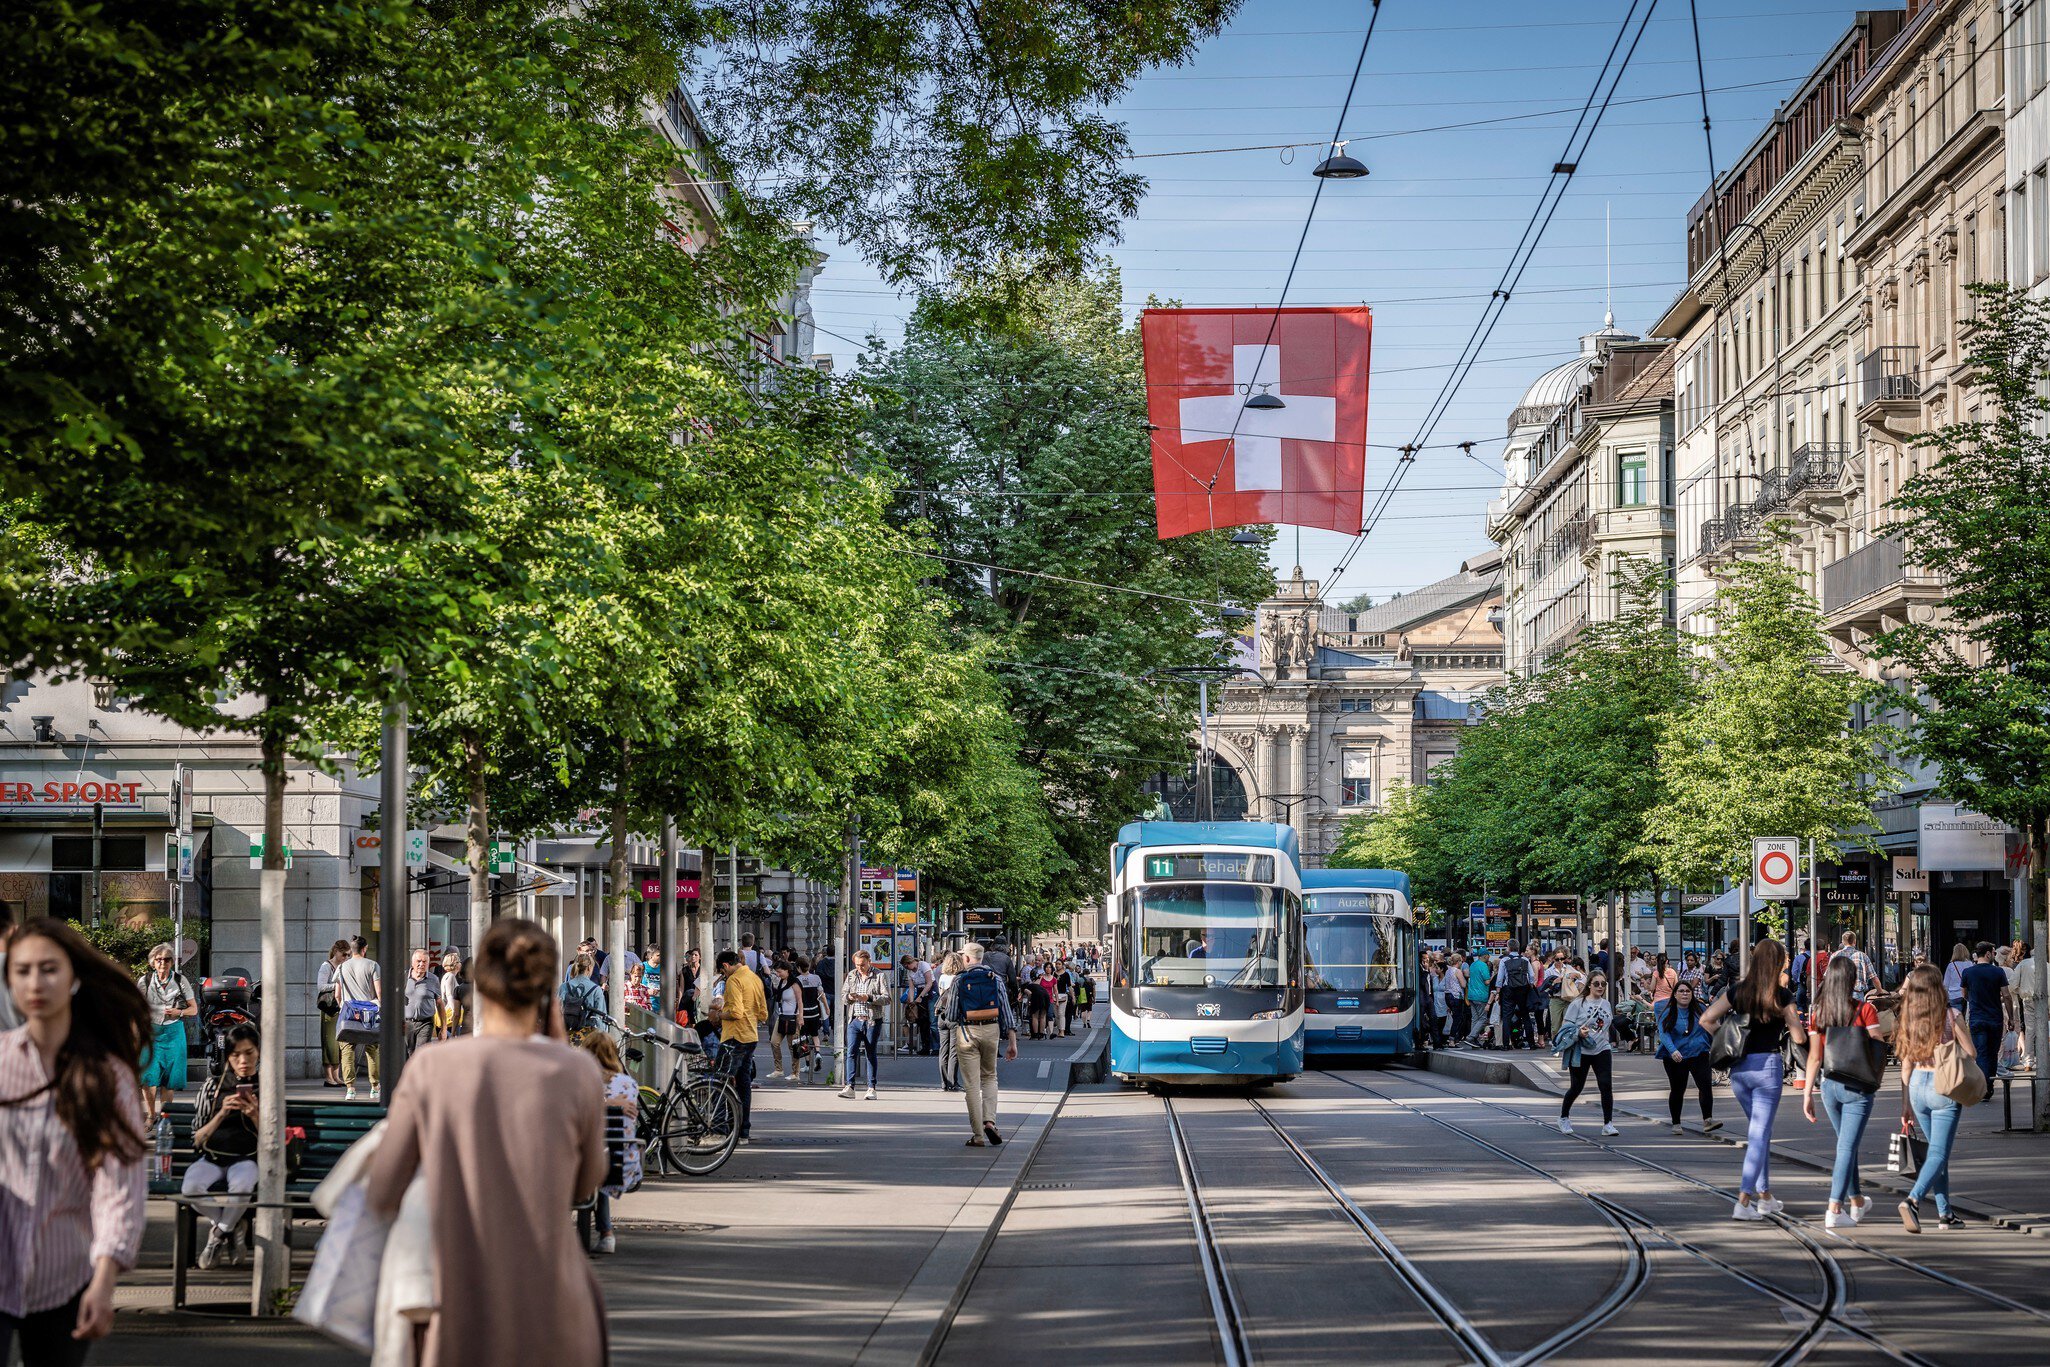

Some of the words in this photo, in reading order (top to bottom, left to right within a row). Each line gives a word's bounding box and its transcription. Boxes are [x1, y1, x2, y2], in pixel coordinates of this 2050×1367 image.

[0, 782, 35, 803] ER
[43, 781, 142, 803] SPORT
[1924, 820, 2007, 831] schminkbar
[1767, 843, 1786, 851] ZONE
[1152, 859, 1170, 874] 11
[1896, 868, 1927, 880] Salt.
[2, 880, 46, 892] CREAM
[648, 885, 694, 893] BEONA
[1305, 897, 1318, 909] 11
